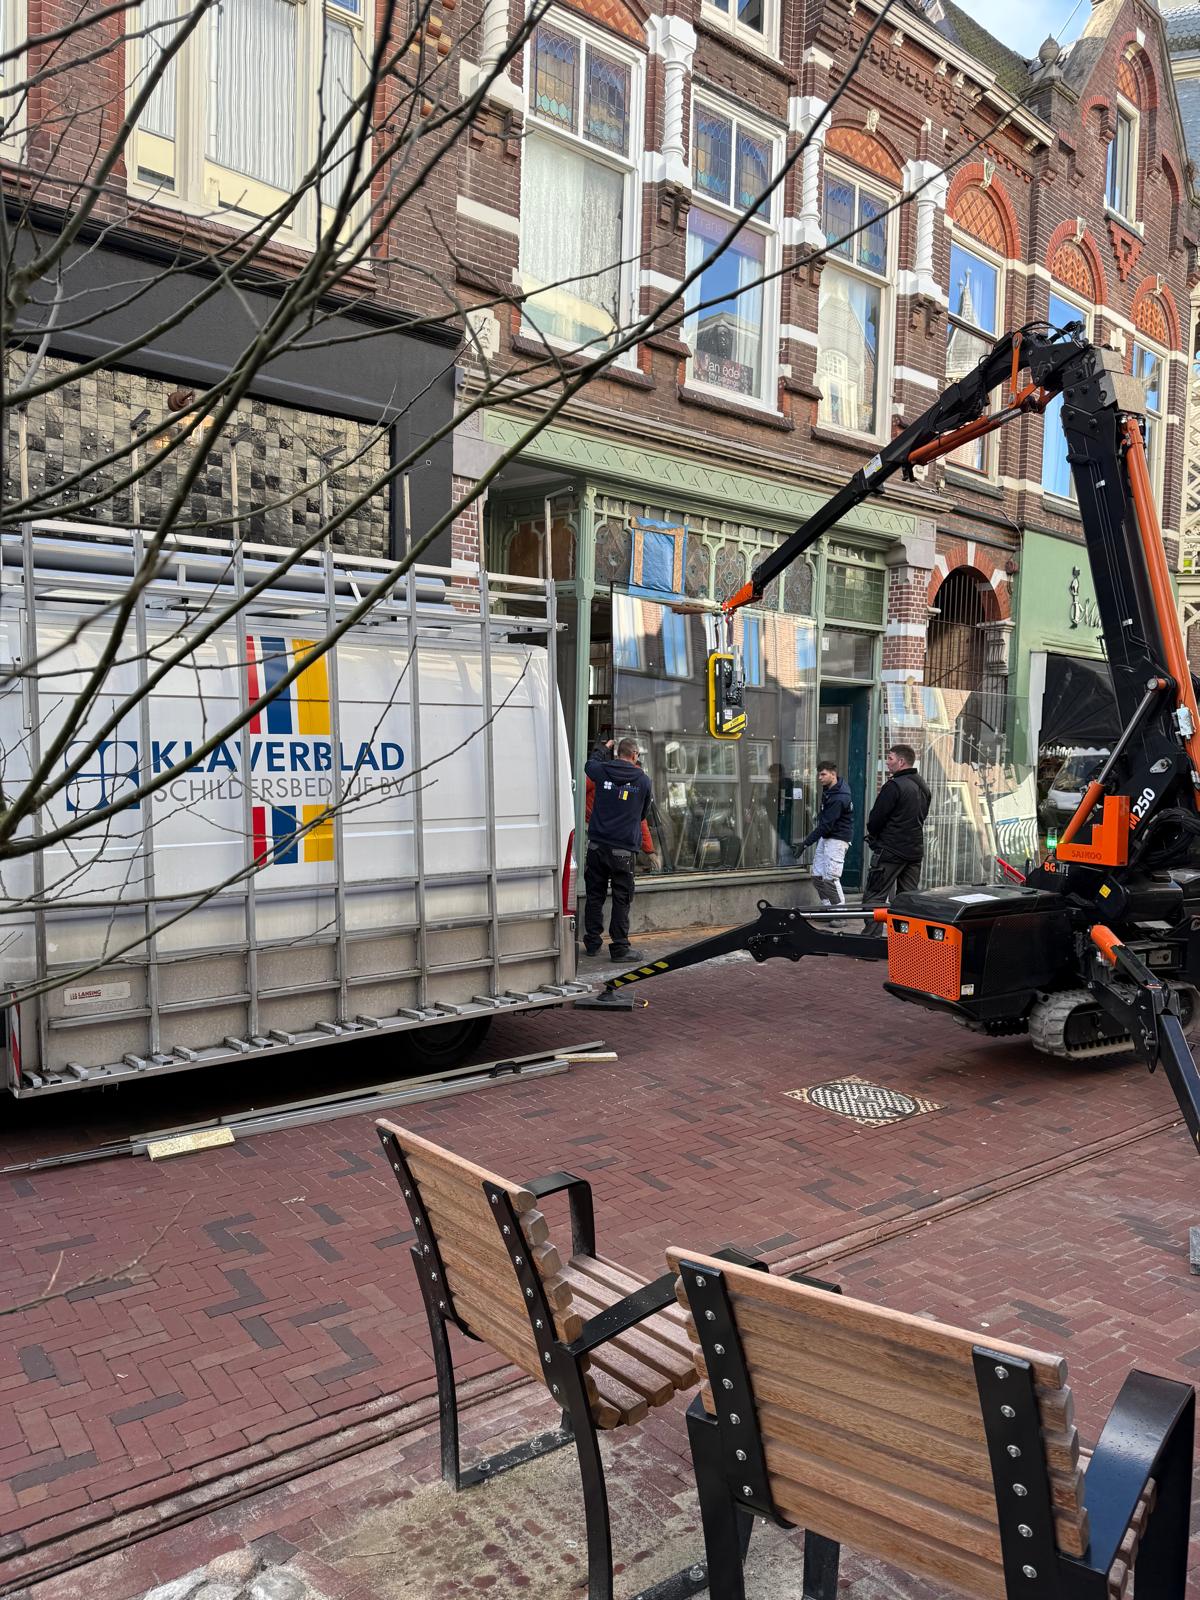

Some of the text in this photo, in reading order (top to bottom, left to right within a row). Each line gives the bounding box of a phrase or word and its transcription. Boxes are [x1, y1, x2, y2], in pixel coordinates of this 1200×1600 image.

[152, 741, 404, 773] KLAVERBLAD
[154, 777, 405, 802] SCHILDERSBEDRIJF BV
[1129, 788, 1155, 830] M250
